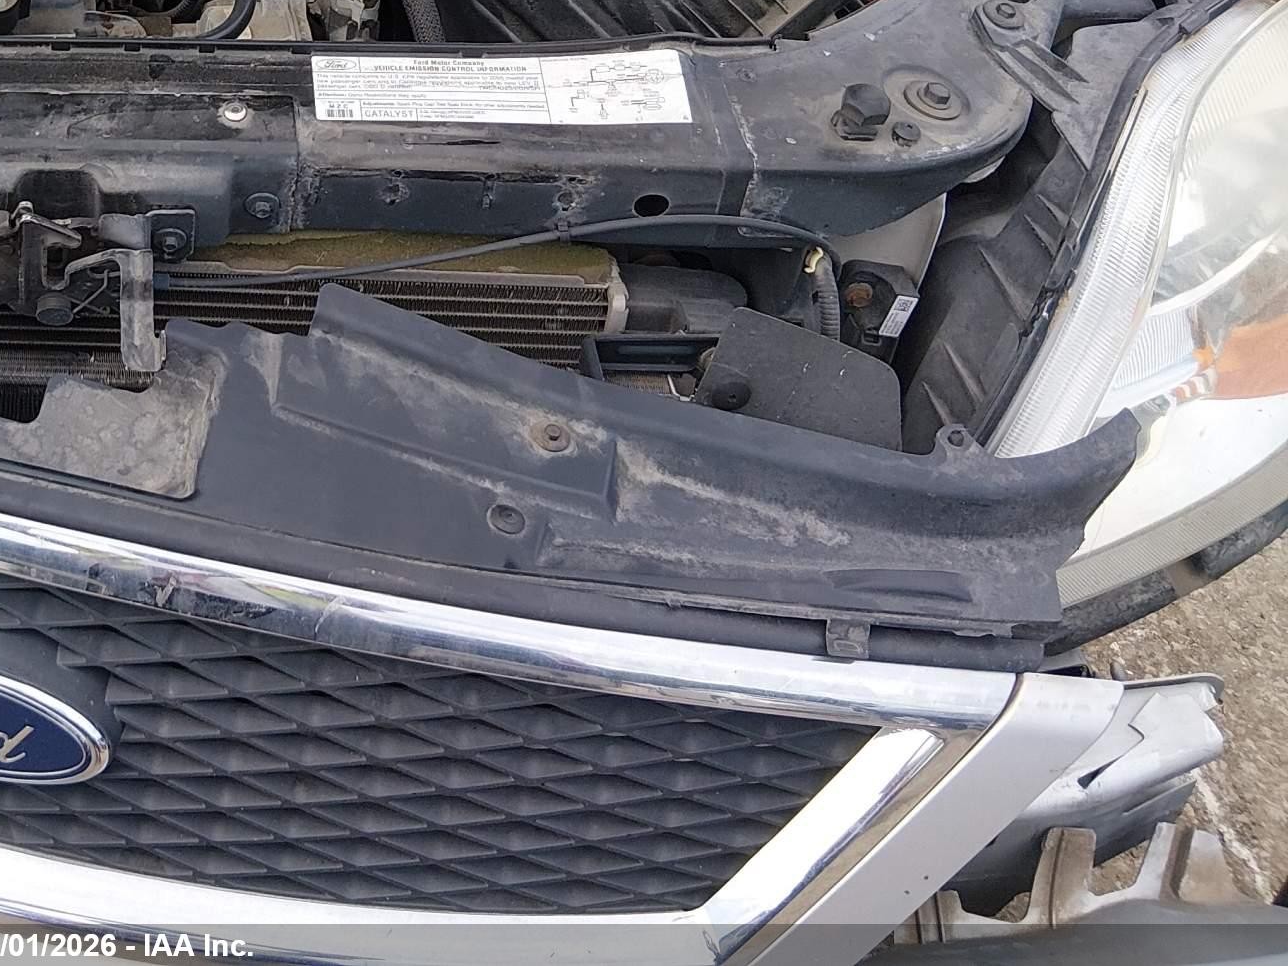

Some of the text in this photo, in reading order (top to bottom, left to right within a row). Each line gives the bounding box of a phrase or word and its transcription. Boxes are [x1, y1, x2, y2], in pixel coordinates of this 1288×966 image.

[405, 65, 440, 73] EMISSION
[441, 65, 475, 73] CONTROL
[364, 109, 413, 118] CATALYST
